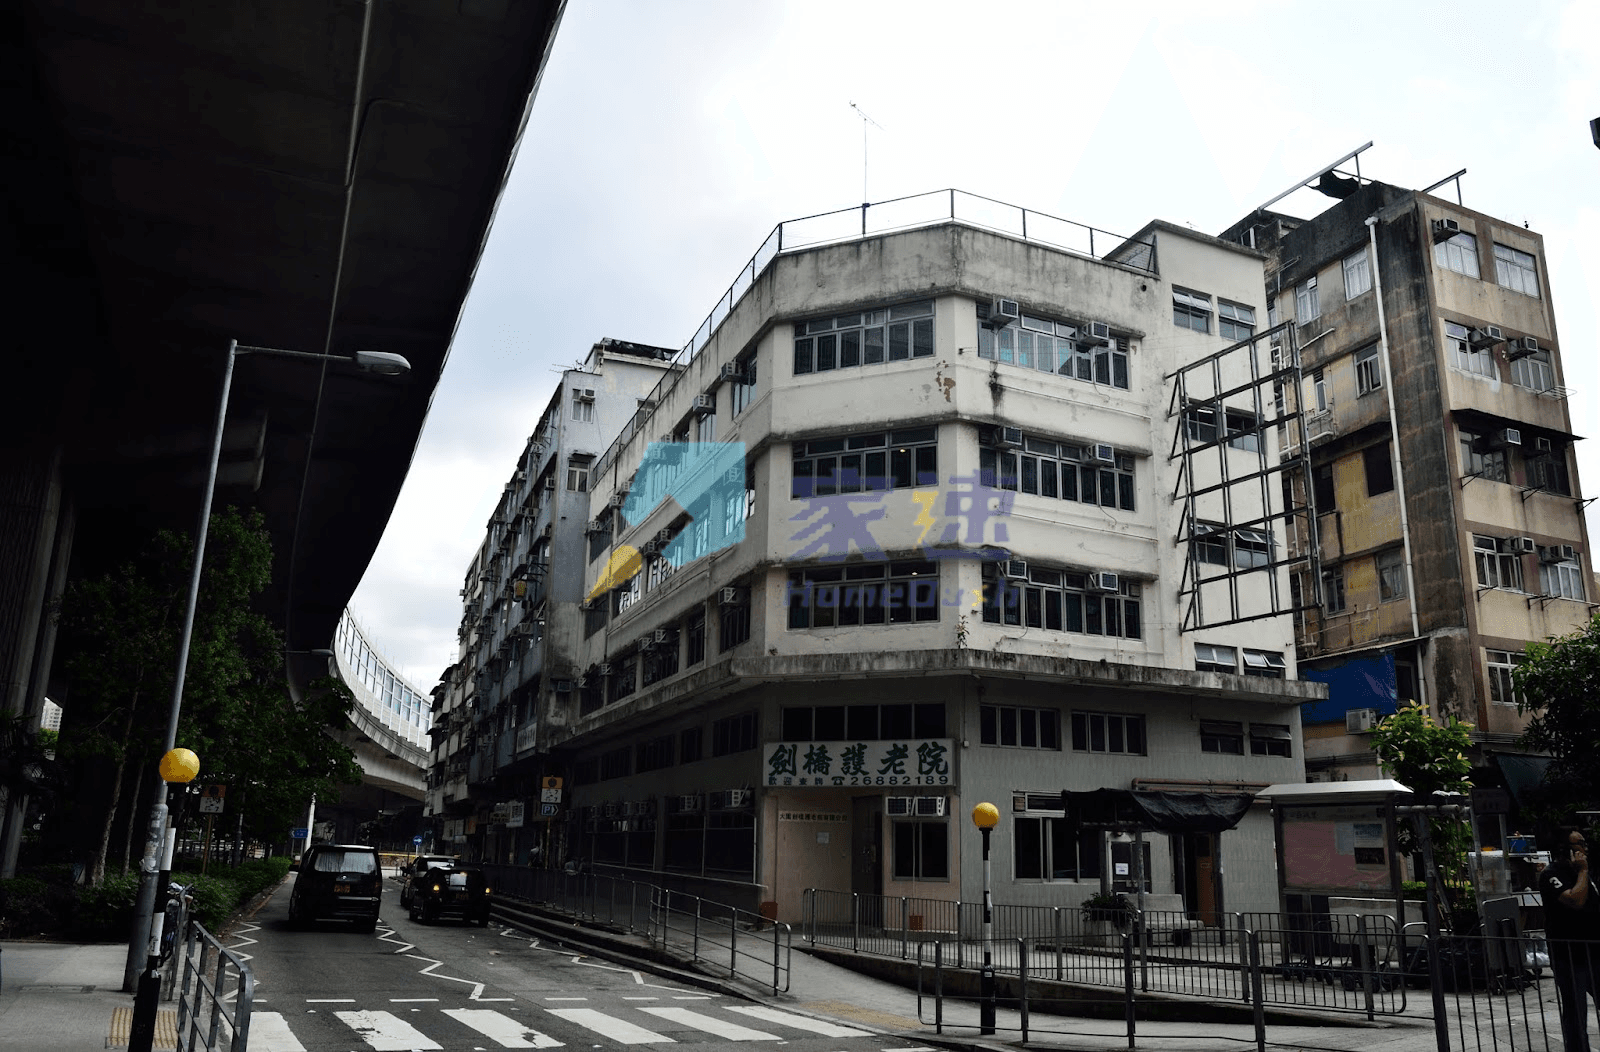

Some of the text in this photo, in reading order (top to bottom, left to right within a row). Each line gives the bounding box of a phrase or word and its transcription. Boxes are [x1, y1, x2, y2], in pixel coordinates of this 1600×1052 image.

[768, 741, 949, 776] 劍橋護老院
[850, 776, 949, 786] 26882189
[1549, 876, 1563, 889] 3
